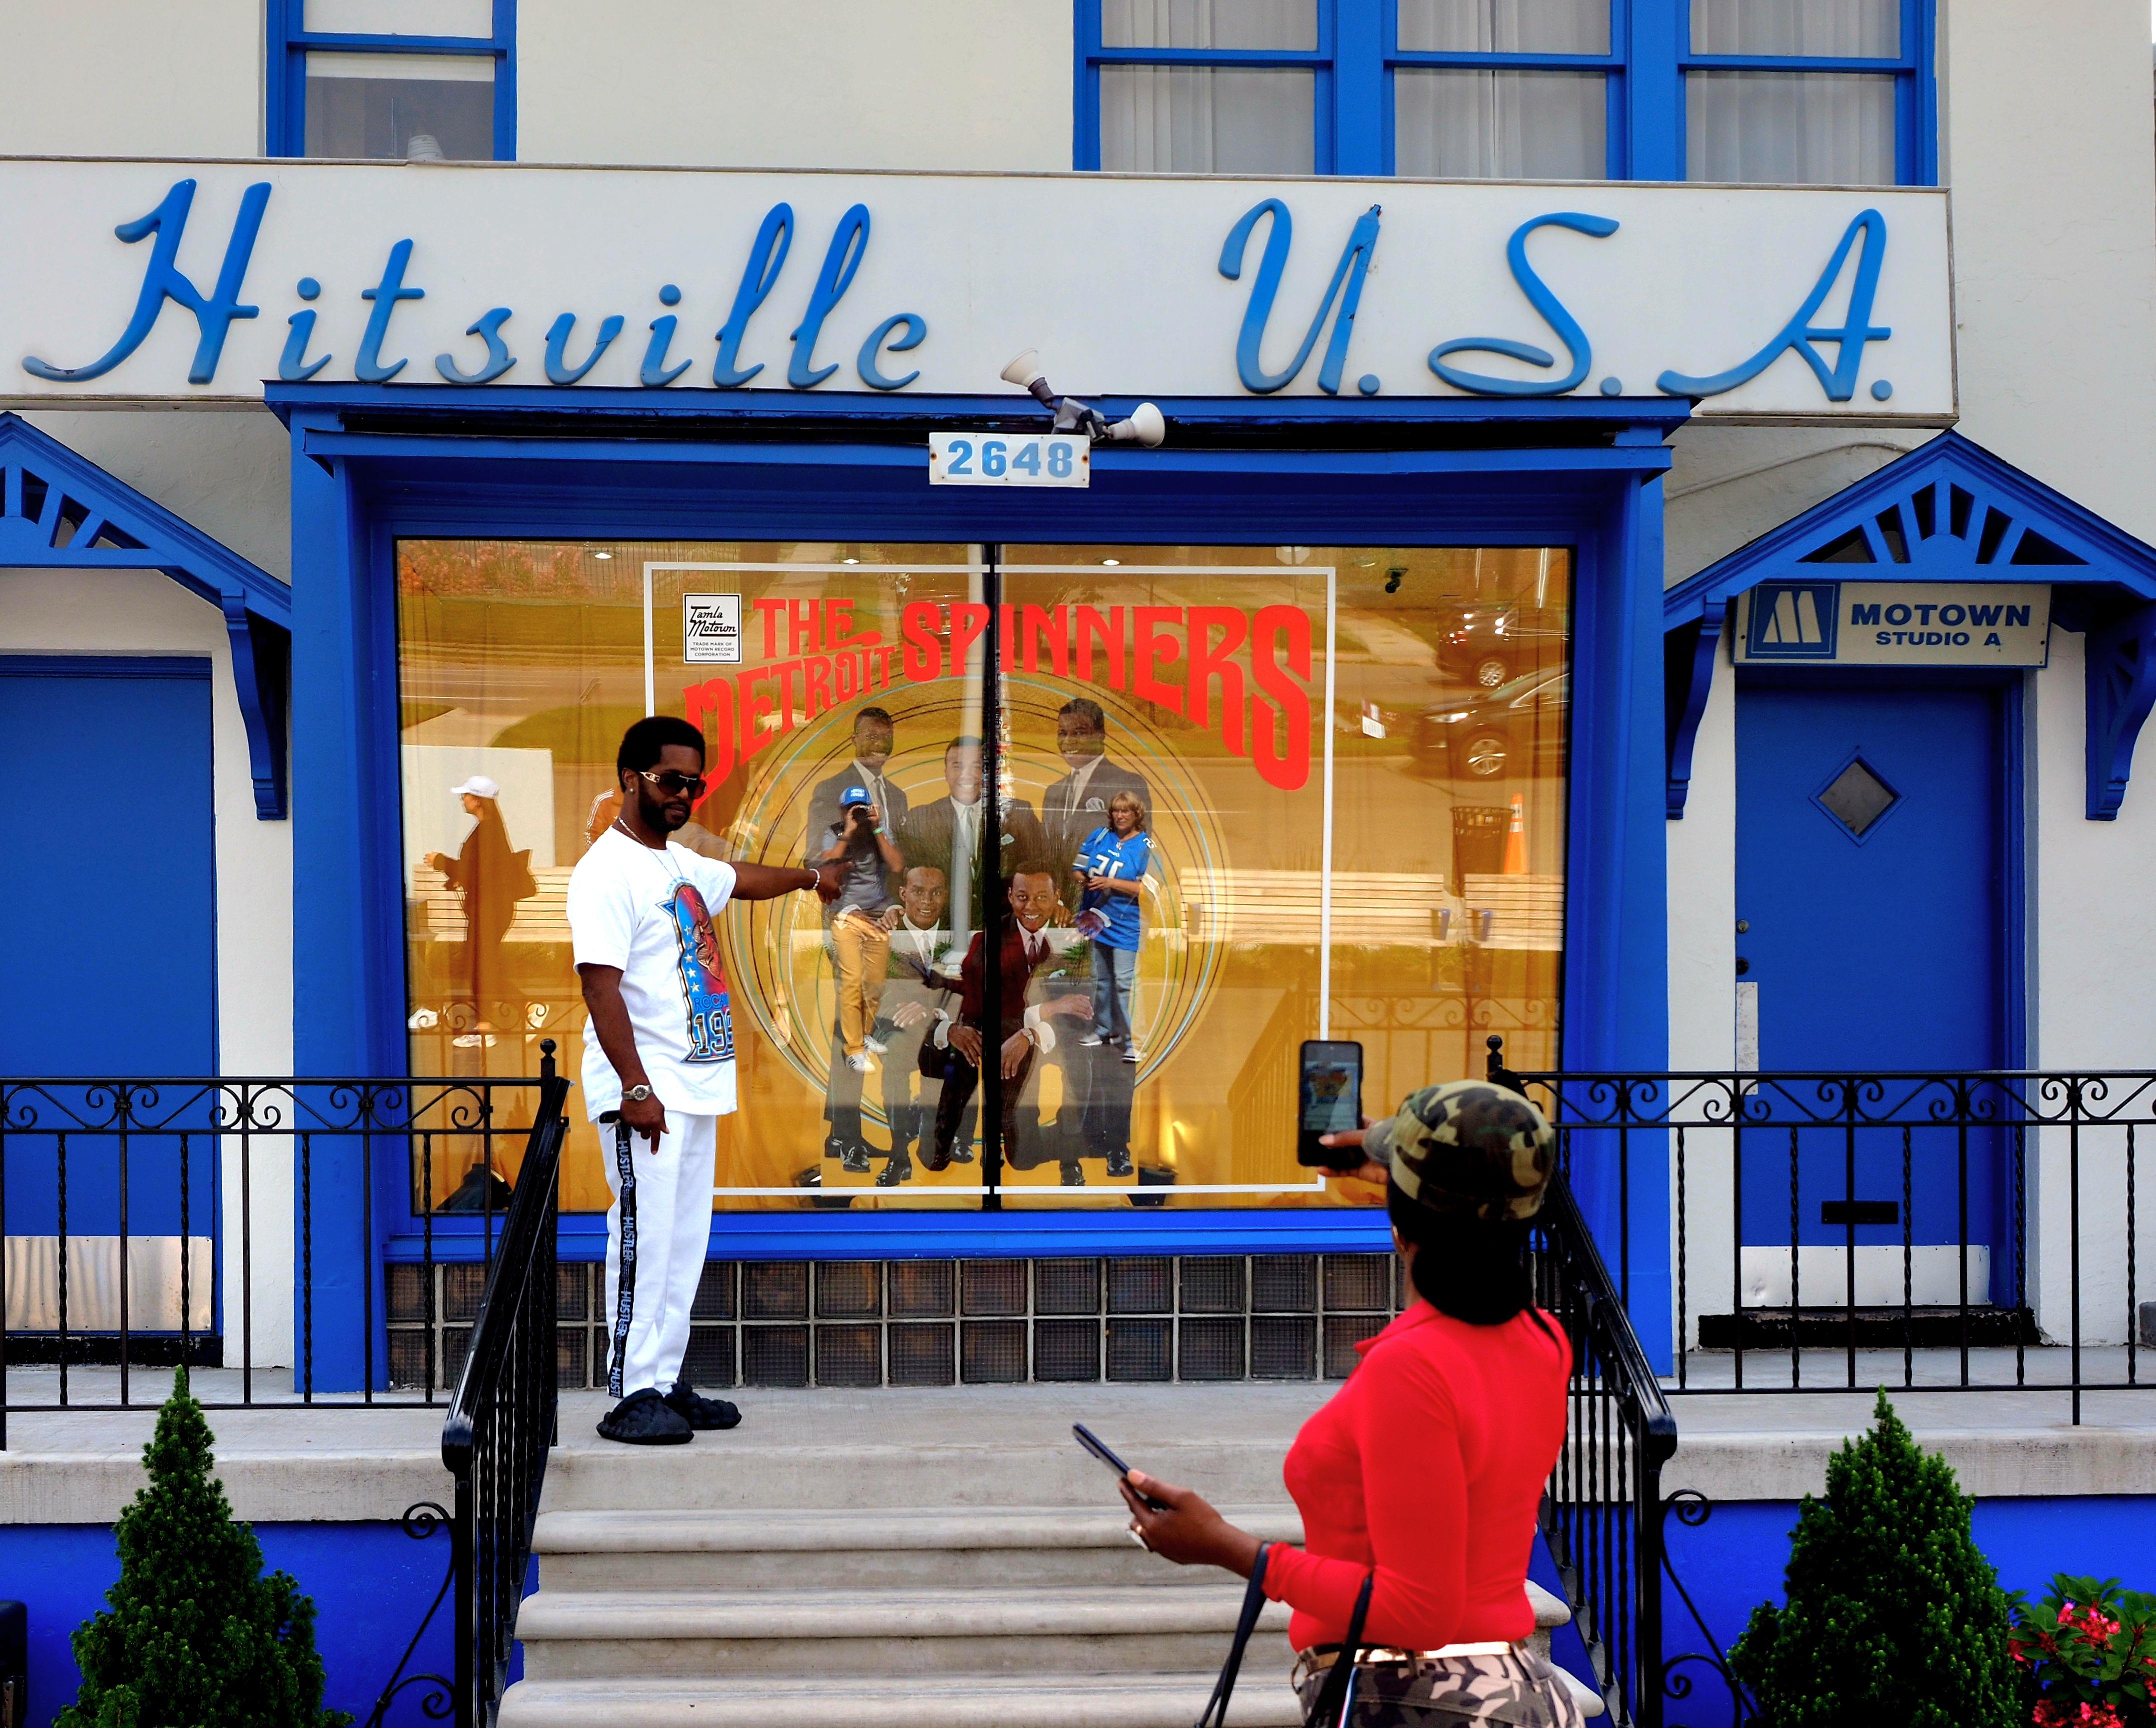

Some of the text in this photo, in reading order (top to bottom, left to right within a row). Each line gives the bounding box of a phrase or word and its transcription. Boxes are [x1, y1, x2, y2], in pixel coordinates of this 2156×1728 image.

[22, 178, 927, 390] Hitsville
[947, 440, 1073, 478] 2648
[687, 620, 737, 637] Motown
[690, 606, 724, 623] Tamla
[753, 598, 883, 659] THE
[1851, 604, 2031, 626] MOTOWN
[1876, 632, 2001, 646] STUDIO A
[682, 602, 1312, 815] DETROIT SPINNERS
[617, 1140, 634, 1188] HUSTLER
[622, 1216, 634, 1262] HUSTLER
[616, 1290, 632, 1338] HUSTLER
